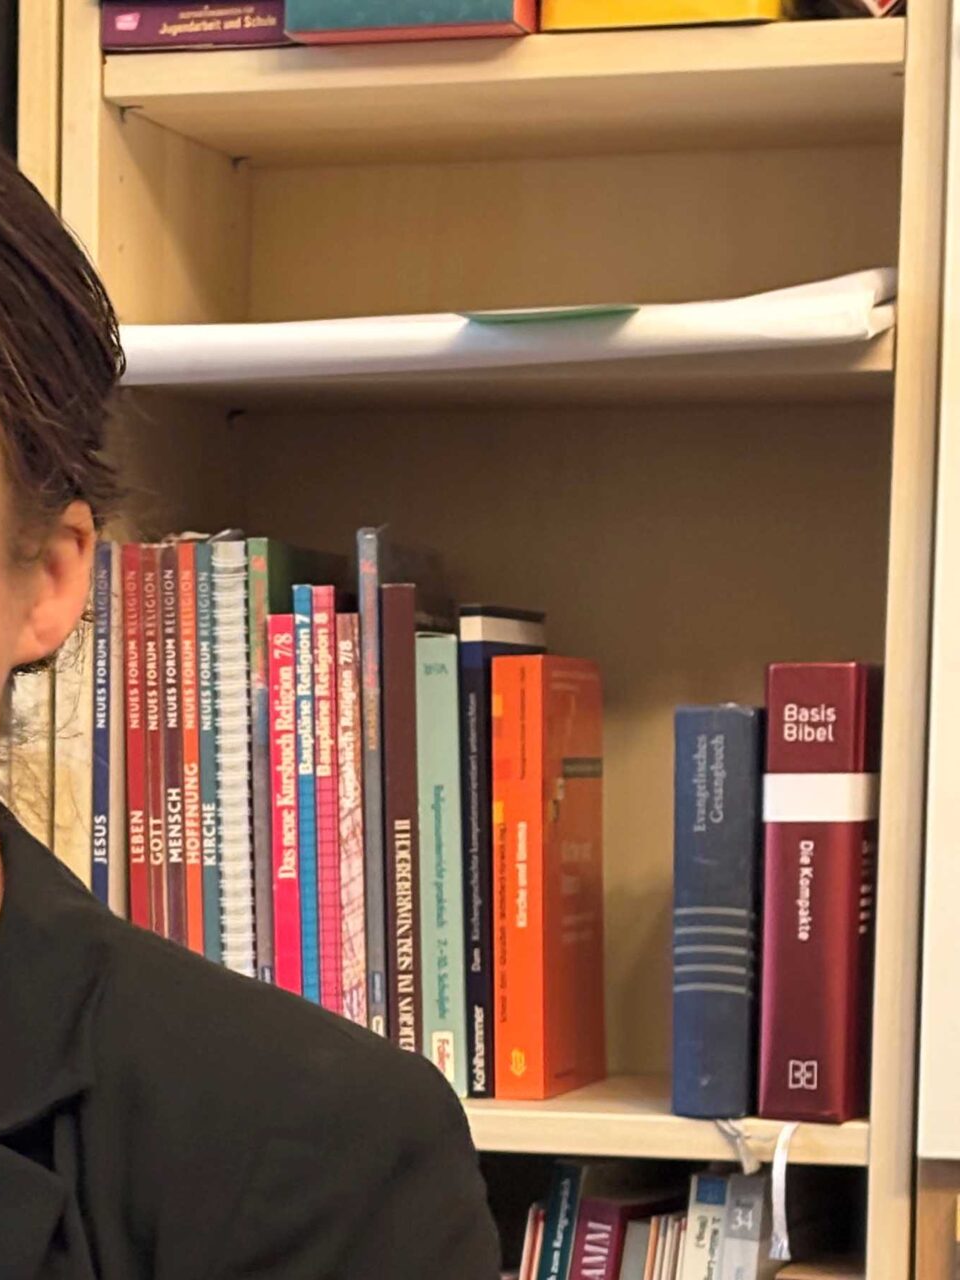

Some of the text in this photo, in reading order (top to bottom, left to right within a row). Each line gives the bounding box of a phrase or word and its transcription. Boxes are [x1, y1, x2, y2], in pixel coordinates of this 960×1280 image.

[158, 15, 277, 36] Jugendarbeit und Schule
[97, 638, 107, 686] FORUM
[128, 640, 138, 685] FORUM
[146, 641, 156, 686] FORUM
[165, 638, 177, 684] FORUM
[183, 639, 193, 685] FORUM
[200, 641, 211, 686] FORUM
[340, 640, 353, 665] 7/8
[96, 689, 107, 729] NEUES
[130, 690, 140, 729] NEUES
[148, 690, 158, 731] NEUES
[167, 687, 178, 729] NEUES
[185, 689, 195, 729] NEUES
[202, 689, 212, 731] NEUES
[295, 613, 315, 775] Baupläne Religion 7
[314, 612, 335, 776] Baupläne Religion 8
[340, 668, 356, 726] Religion
[783, 703, 837, 723] Basis
[274, 633, 297, 879] Das neue Kursbuch Religion 7/8
[783, 723, 835, 742] Bibel
[693, 734, 708, 832] Evangelisches
[709, 734, 727, 823] Gesangbuch
[131, 810, 144, 864] LEBEN
[169, 787, 182, 863] MENSCH
[186, 763, 200, 864] HOFFNUNG
[203, 802, 216, 866] KIRCHE
[94, 814, 107, 863] JESUS
[150, 817, 162, 865] GOTT
[394, 833, 413, 972] SEKUNDARBEREICH
[796, 840, 814, 942] Die Kompakte
[398, 974, 414, 994] IM
[399, 997, 415, 1052] ELIGION
[473, 1005, 485, 1092] Kohlhammer
[550, 1250, 560, 1274] zum
